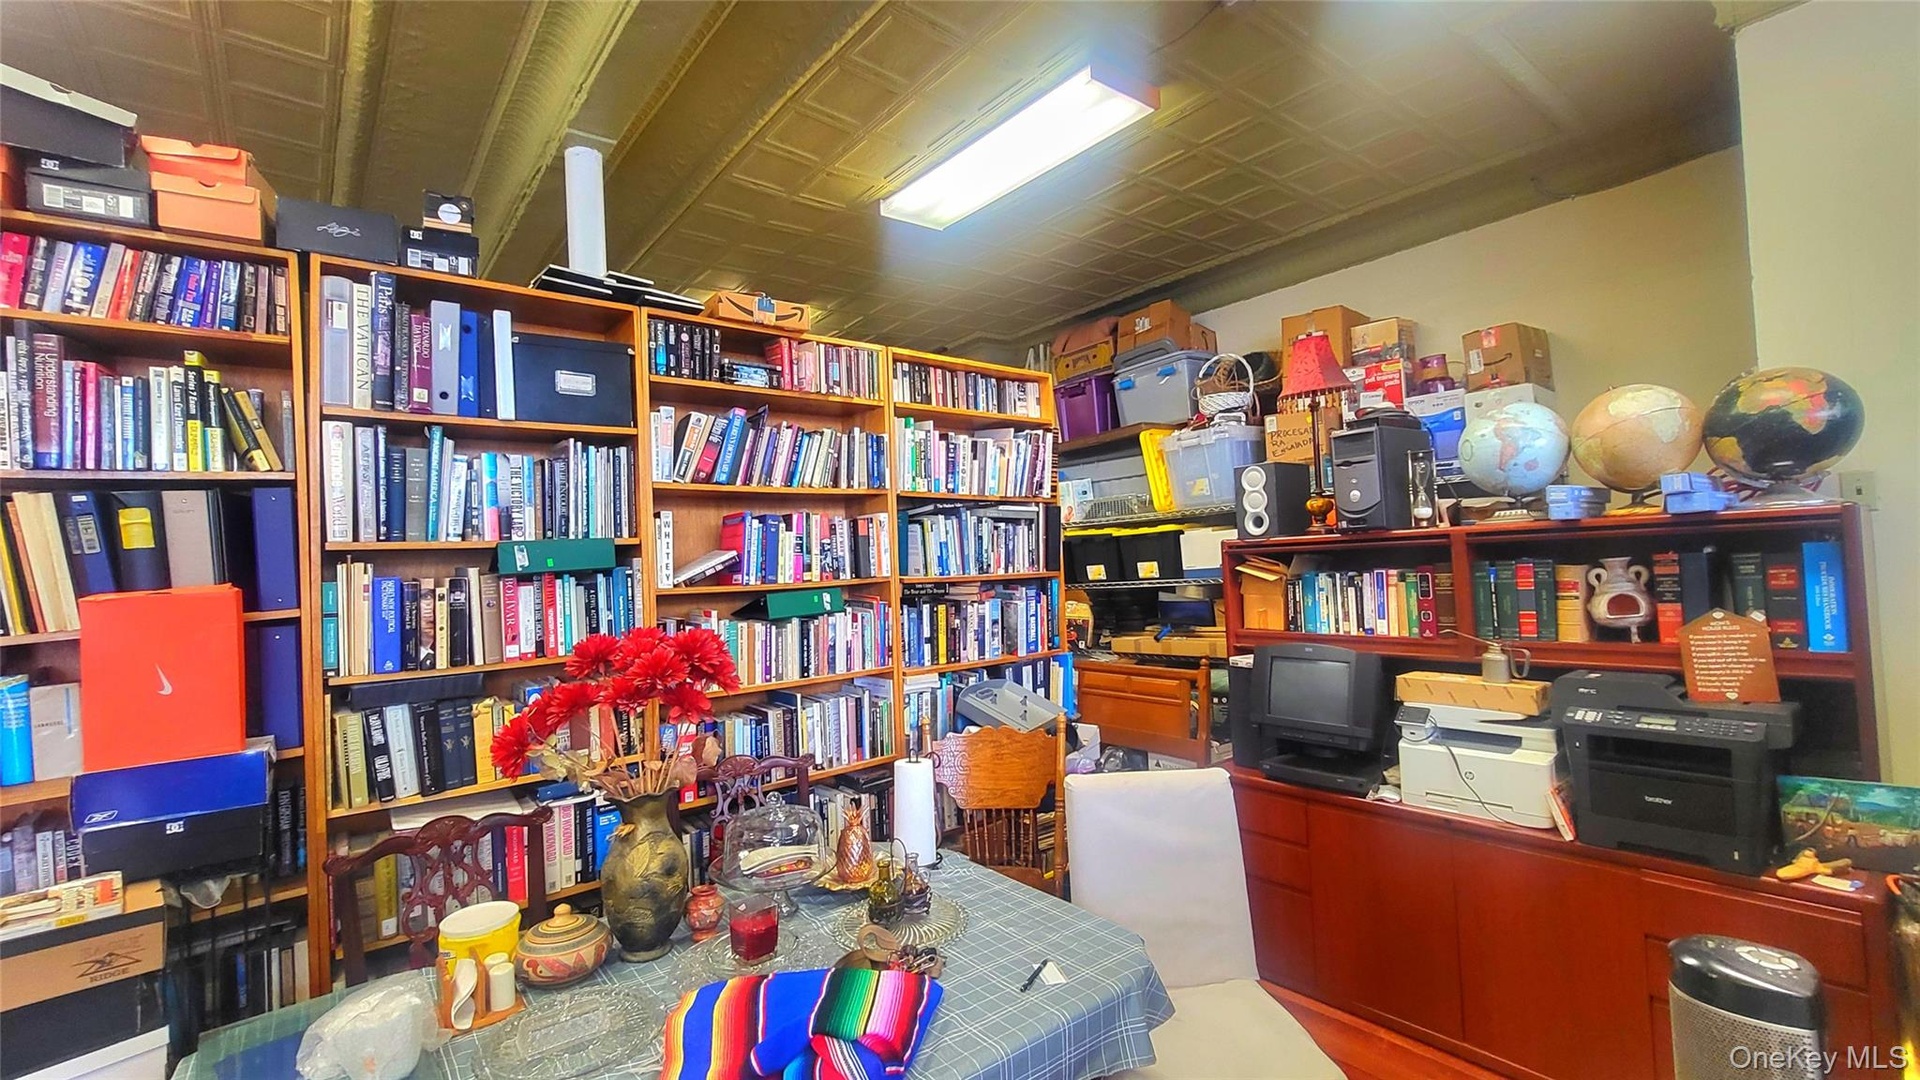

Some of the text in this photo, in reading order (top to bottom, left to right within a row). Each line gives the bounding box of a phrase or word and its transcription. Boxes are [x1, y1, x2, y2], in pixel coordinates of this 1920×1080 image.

[378, 284, 393, 315] Paris
[402, 307, 410, 325] PABLO
[356, 289, 370, 392] THE VATICAN
[413, 324, 422, 337] DA
[422, 321, 431, 359] LEONARDO
[34, 352, 46, 390] Nutrition
[188, 370, 197, 390] Series
[1365, 372, 1400, 384] pet training
[44, 352, 58, 418] Understanding
[173, 385, 182, 402] Lawn
[207, 384, 215, 403] Property
[1384, 379, 1400, 388] pads
[174, 402, 184, 418] Care
[190, 397, 198, 414] Exam
[1270, 427, 1313, 441] PROCESA
[431, 441, 442, 503] ANCIENT AMERICA
[510, 466, 522, 479] THE
[559, 462, 568, 472] MY
[510, 482, 523, 515] VICTORY
[332, 495, 347, 526] World
[663, 520, 672, 582] WHITEY
[381, 580, 389, 610] DICTIONARY
[533, 582, 542, 604] REQUIEM
[387, 610, 396, 634] POLITICAL
[590, 610, 598, 628] ACTION
[1823, 597, 1833, 631] HANDBOOK
[535, 621, 544, 642] TROPICS
[421, 732, 429, 747] Buffett
[833, 711, 842, 756] TUROW
[563, 805, 574, 856] BOB WOODWARD
[66, 838, 81, 868] CODEX
[546, 825, 557, 863] WOODWARD
[89, 967, 129, 983] RIDGE
